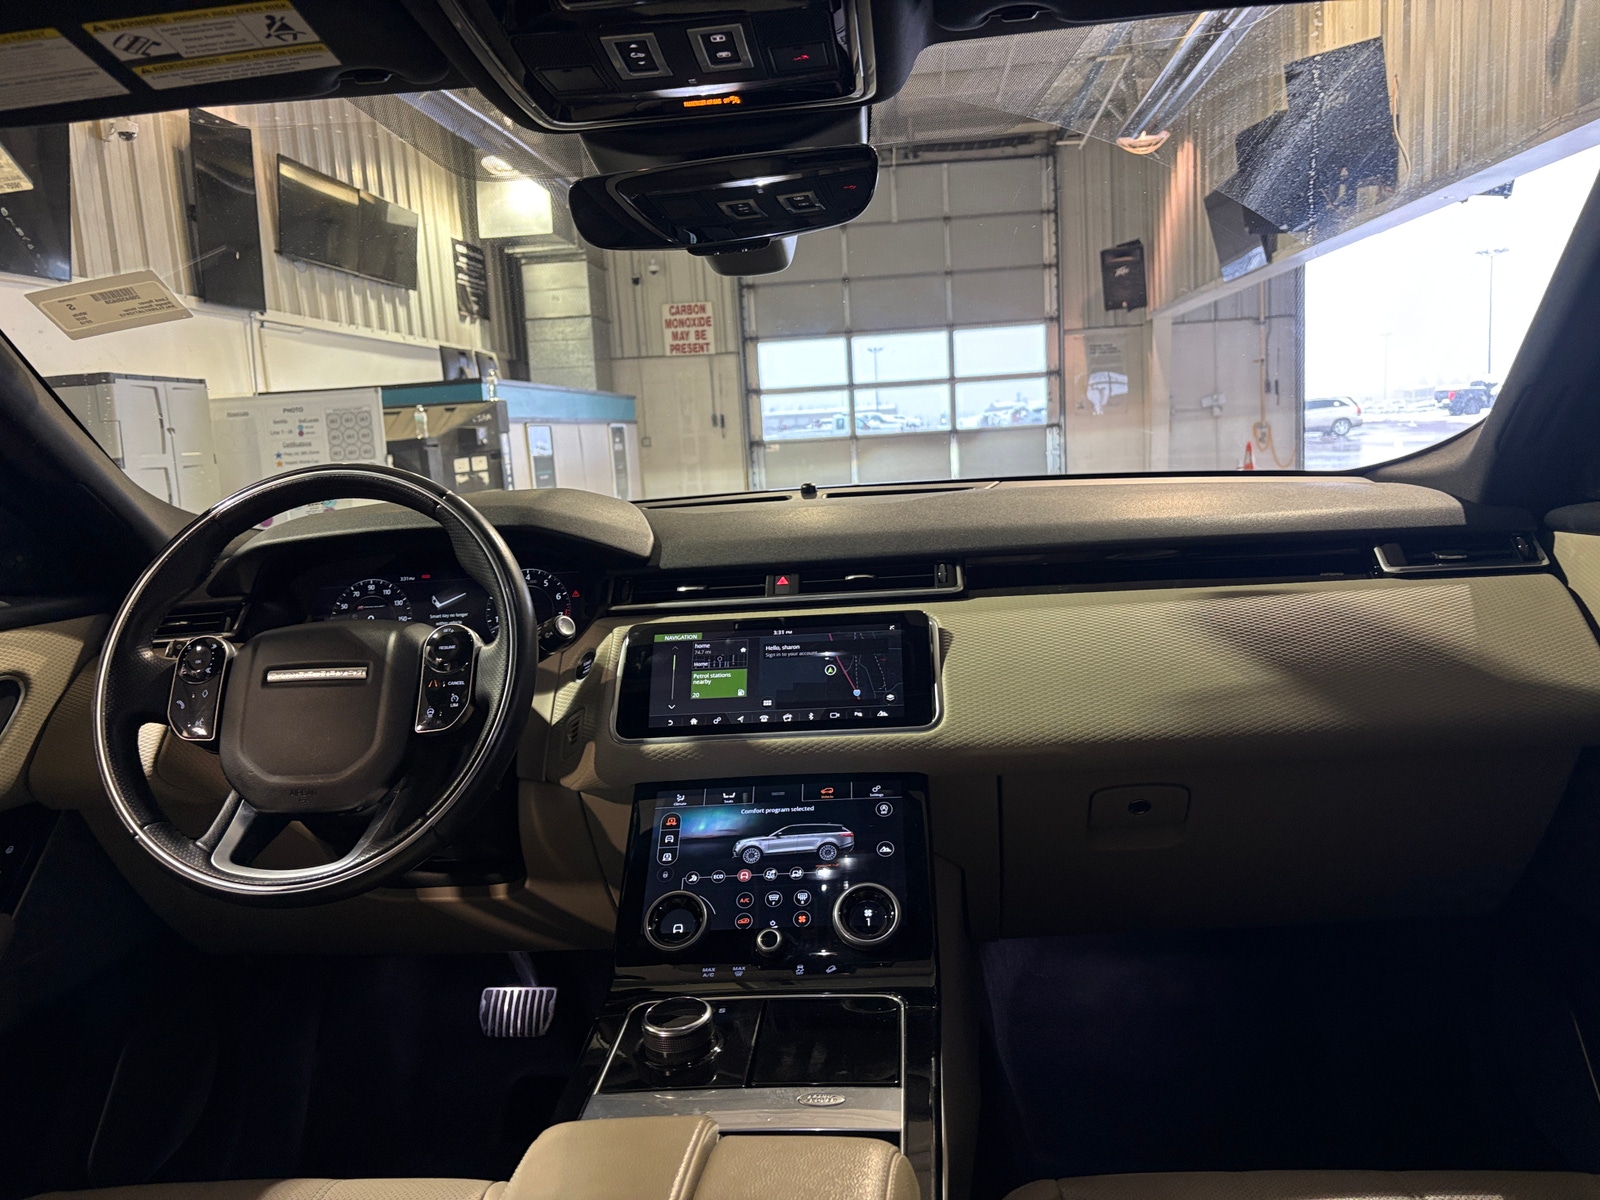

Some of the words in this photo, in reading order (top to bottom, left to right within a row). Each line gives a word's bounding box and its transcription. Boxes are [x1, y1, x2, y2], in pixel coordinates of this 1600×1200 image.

[668, 303, 706, 316] CARBON
[664, 316, 712, 329] MONOXIDE
[671, 330, 690, 341] MAY
[694, 329, 707, 341] BE
[669, 342, 710, 354] PRESENT
[543, 579, 549, 587] 5
[866, 918, 870, 927] 1
